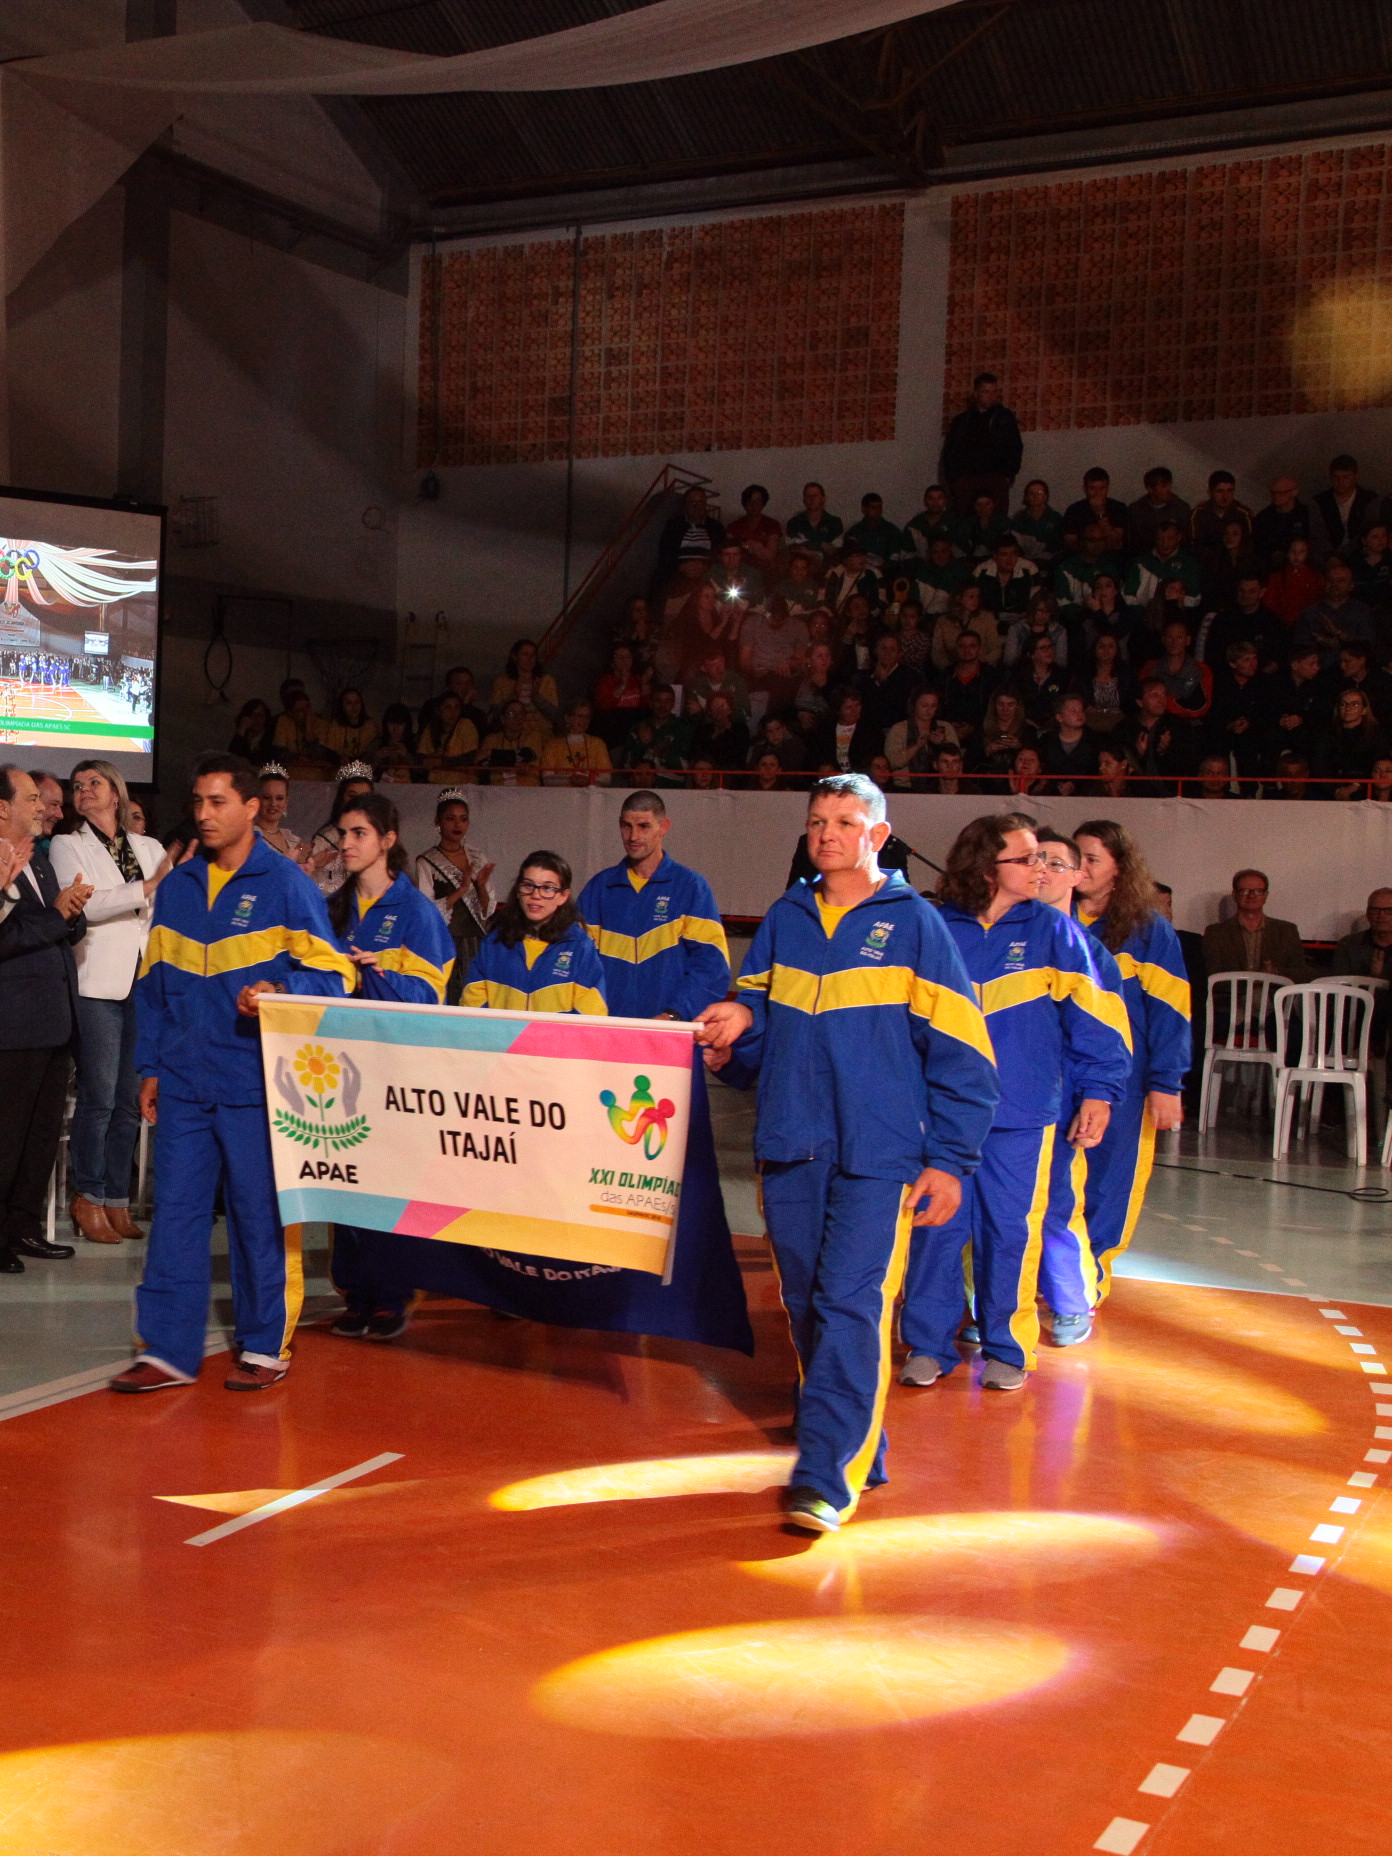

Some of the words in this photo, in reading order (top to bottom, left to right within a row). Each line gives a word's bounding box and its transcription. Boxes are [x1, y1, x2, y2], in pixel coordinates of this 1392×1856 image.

[385, 1085, 445, 1116] ALTO
[454, 1091, 520, 1125] VALE
[529, 1100, 566, 1130] DO
[439, 1130, 517, 1164] ITAJAÍ
[299, 1160, 359, 1184] APAE
[589, 1167, 615, 1186] XXI
[600, 1190, 623, 1204] das
[542, 1268, 573, 1281] DO
